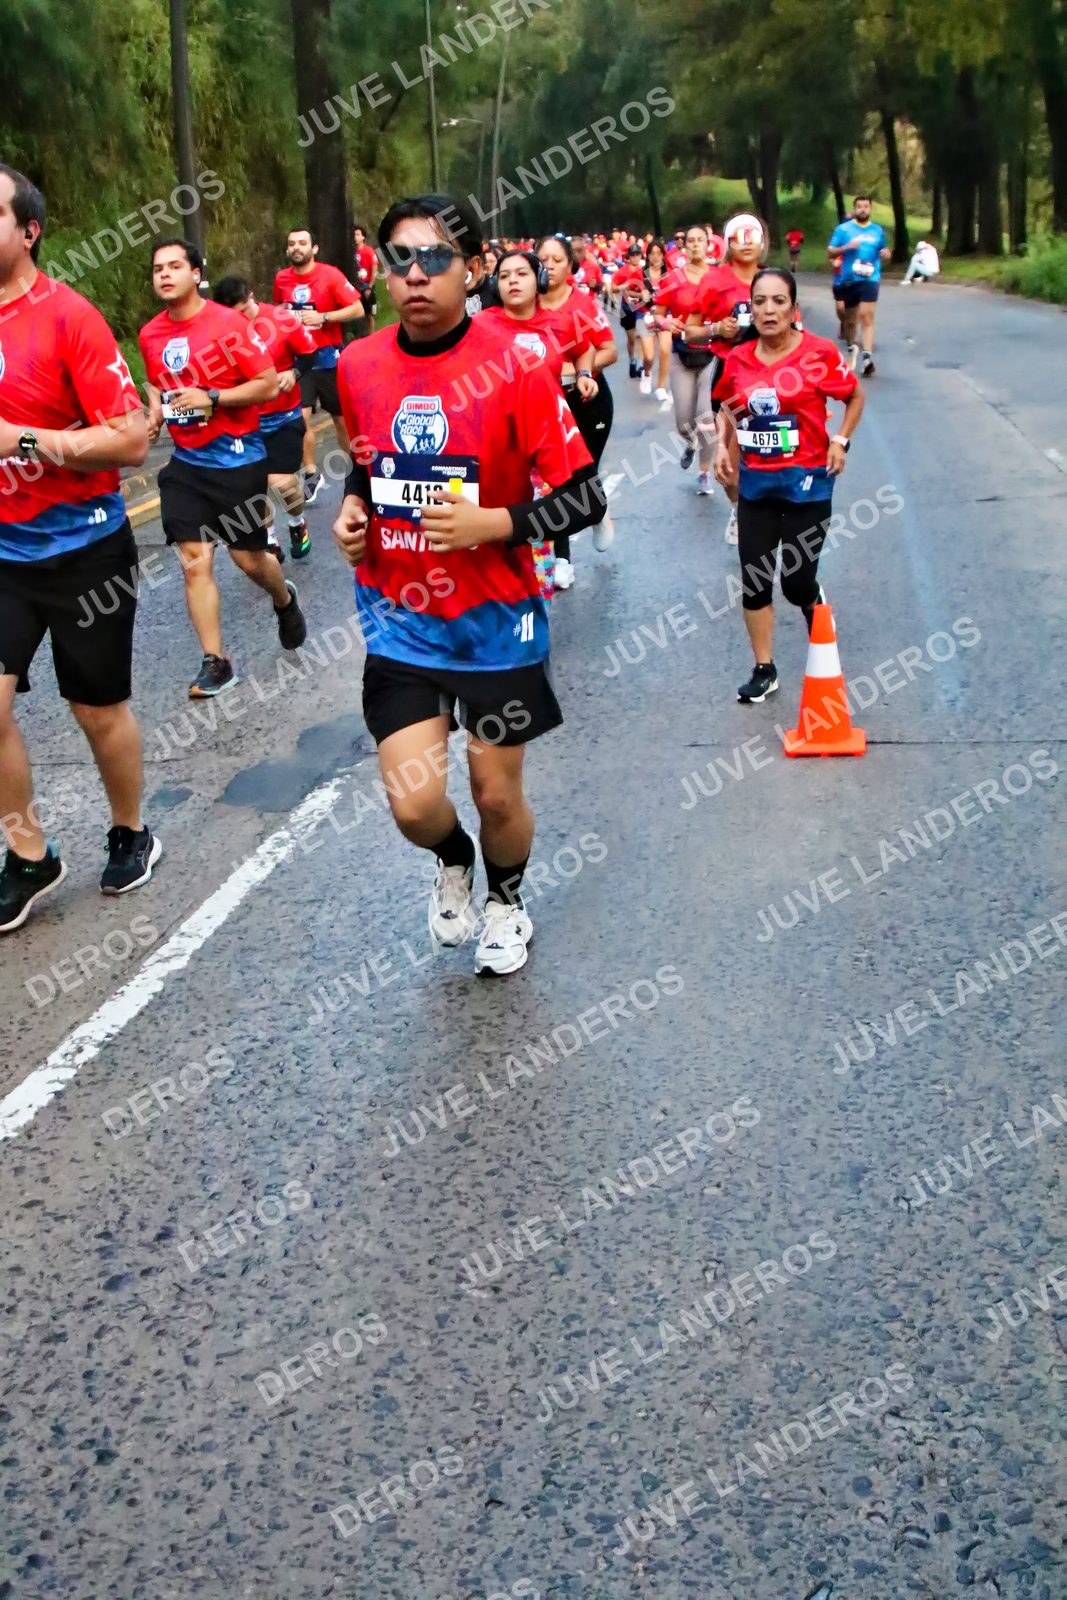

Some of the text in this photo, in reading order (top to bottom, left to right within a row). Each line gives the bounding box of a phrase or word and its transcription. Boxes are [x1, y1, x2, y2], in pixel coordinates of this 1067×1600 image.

[406, 402, 436, 410] BIMBO
[406, 414, 434, 426] Global
[400, 424, 424, 435] Race
[752, 432, 778, 446] 4679
[402, 483, 443, 505] 4412
[513, 611, 534, 642] #11
